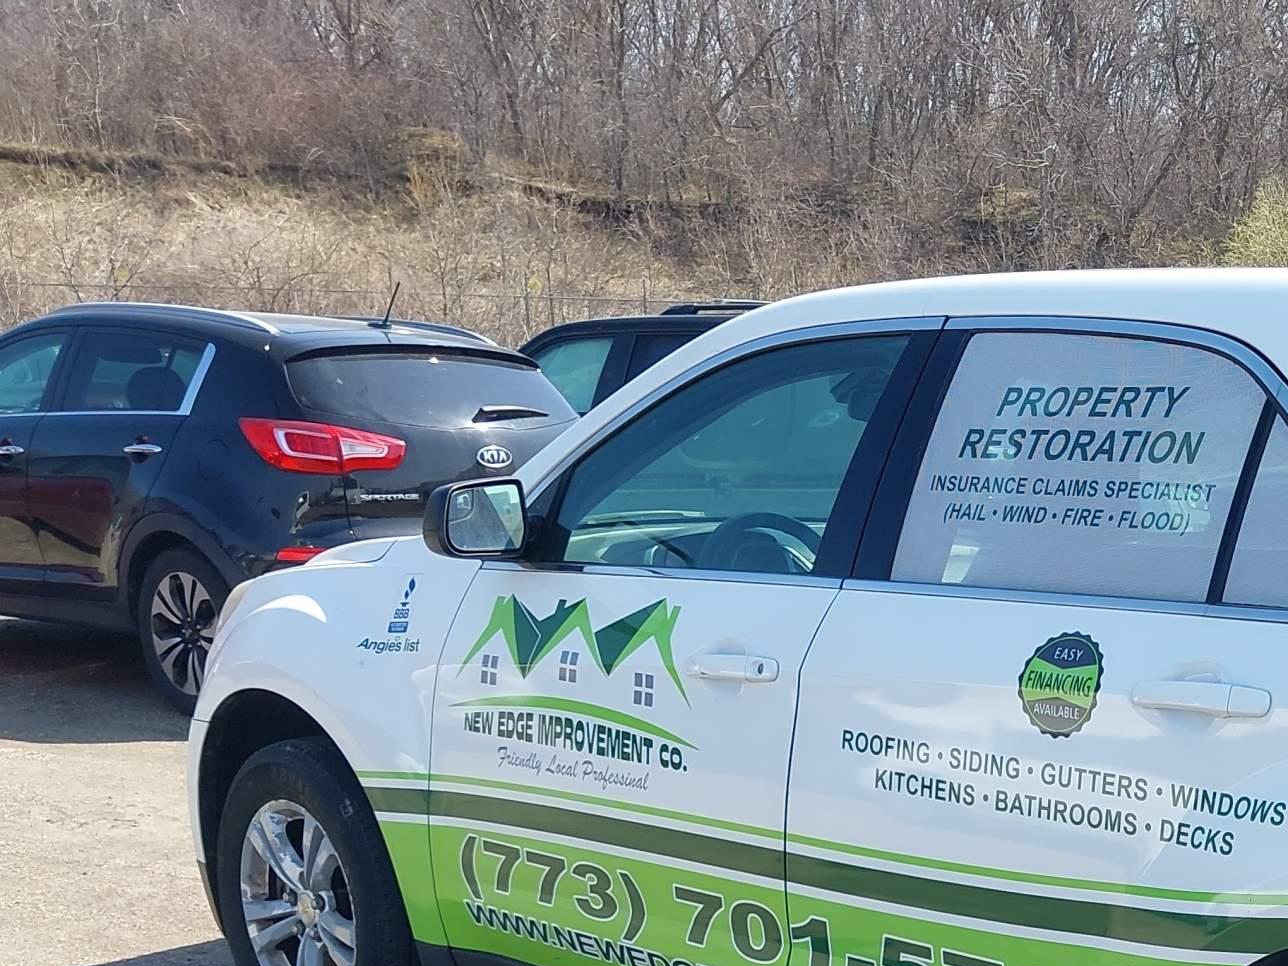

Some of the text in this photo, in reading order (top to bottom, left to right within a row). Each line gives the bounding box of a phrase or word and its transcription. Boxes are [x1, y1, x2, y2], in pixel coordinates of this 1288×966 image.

[996, 386, 1191, 419] PROPERTY
[483, 451, 508, 462] KIA
[958, 428, 1205, 465] RESTORATION
[930, 474, 1216, 503] INSURANCE CLAIMS SPECIALIST
[943, 502, 1191, 536] (HAIL WIND FIRE FLOOD)
[1054, 647, 1083, 661] EASY
[1025, 670, 1092, 697] FINANCING
[1033, 703, 1080, 720] AVAILABLE
[464, 711, 688, 772] NEW EDGE IMPROVEMENT CO.
[496, 747, 542, 776] Friendly
[545, 754, 578, 778] Local
[841, 729, 1287, 826] ROOFING SIDING GUTTERS WINDOWS
[874, 768, 1235, 856] KITCHENS BATHROOMS DECKS
[460, 833, 647, 944] (773)
